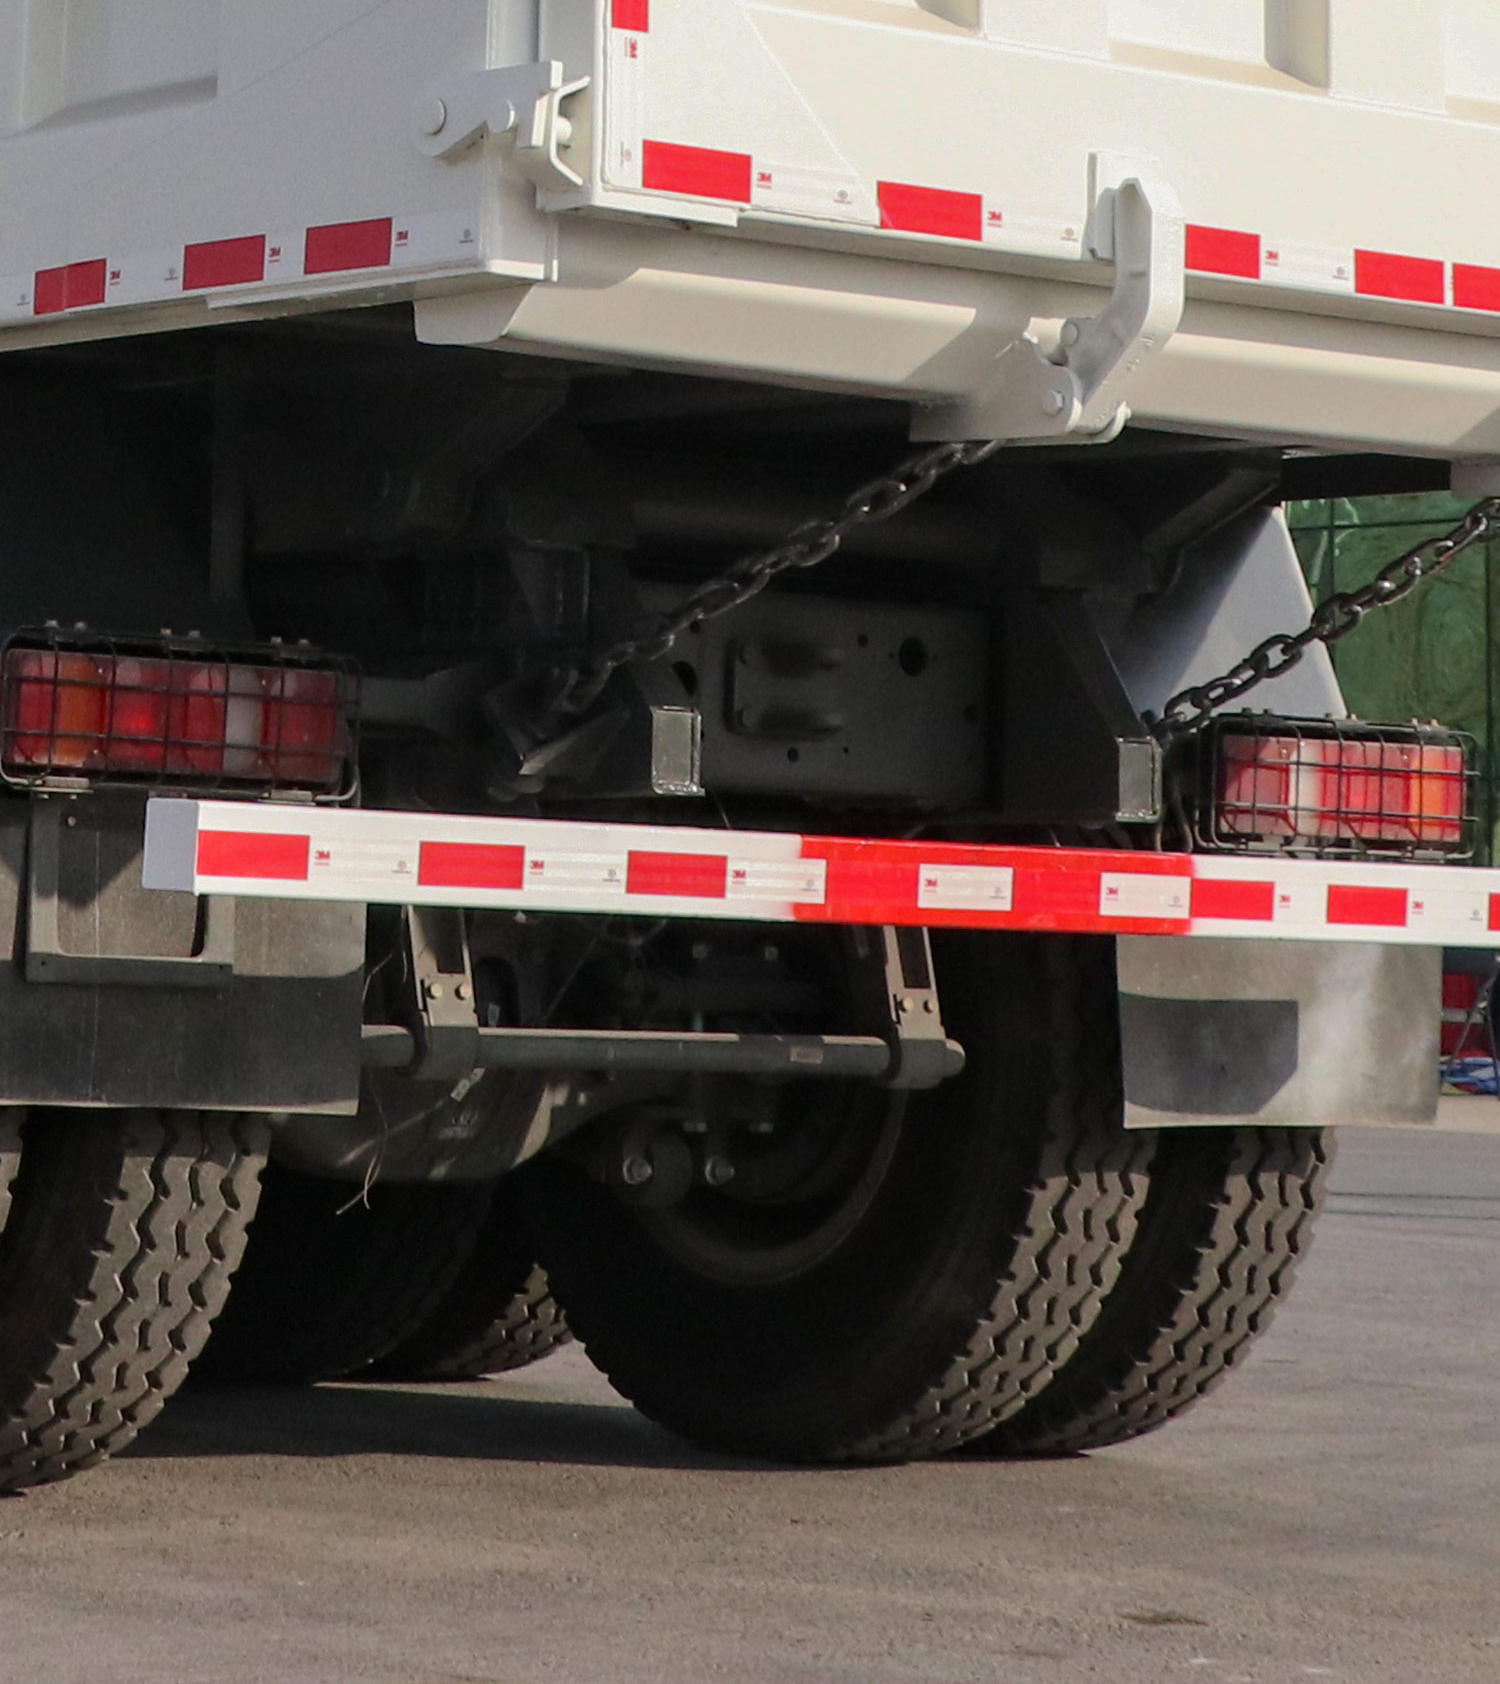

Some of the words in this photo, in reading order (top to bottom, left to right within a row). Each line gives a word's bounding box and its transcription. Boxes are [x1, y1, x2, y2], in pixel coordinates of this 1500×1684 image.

[629, 38, 638, 59] 3M
[757, 172, 772, 183] 3M
[987, 210, 1002, 221] 3M
[396, 230, 408, 241] 3M
[268, 247, 281, 257] 3M
[1265, 250, 1278, 260] 3M
[314, 850, 330, 860] 3M
[530, 860, 544, 869] 3M
[732, 869, 746, 878] 3M
[924, 878, 938, 887] 3M
[1105, 886, 1118, 895] 3M
